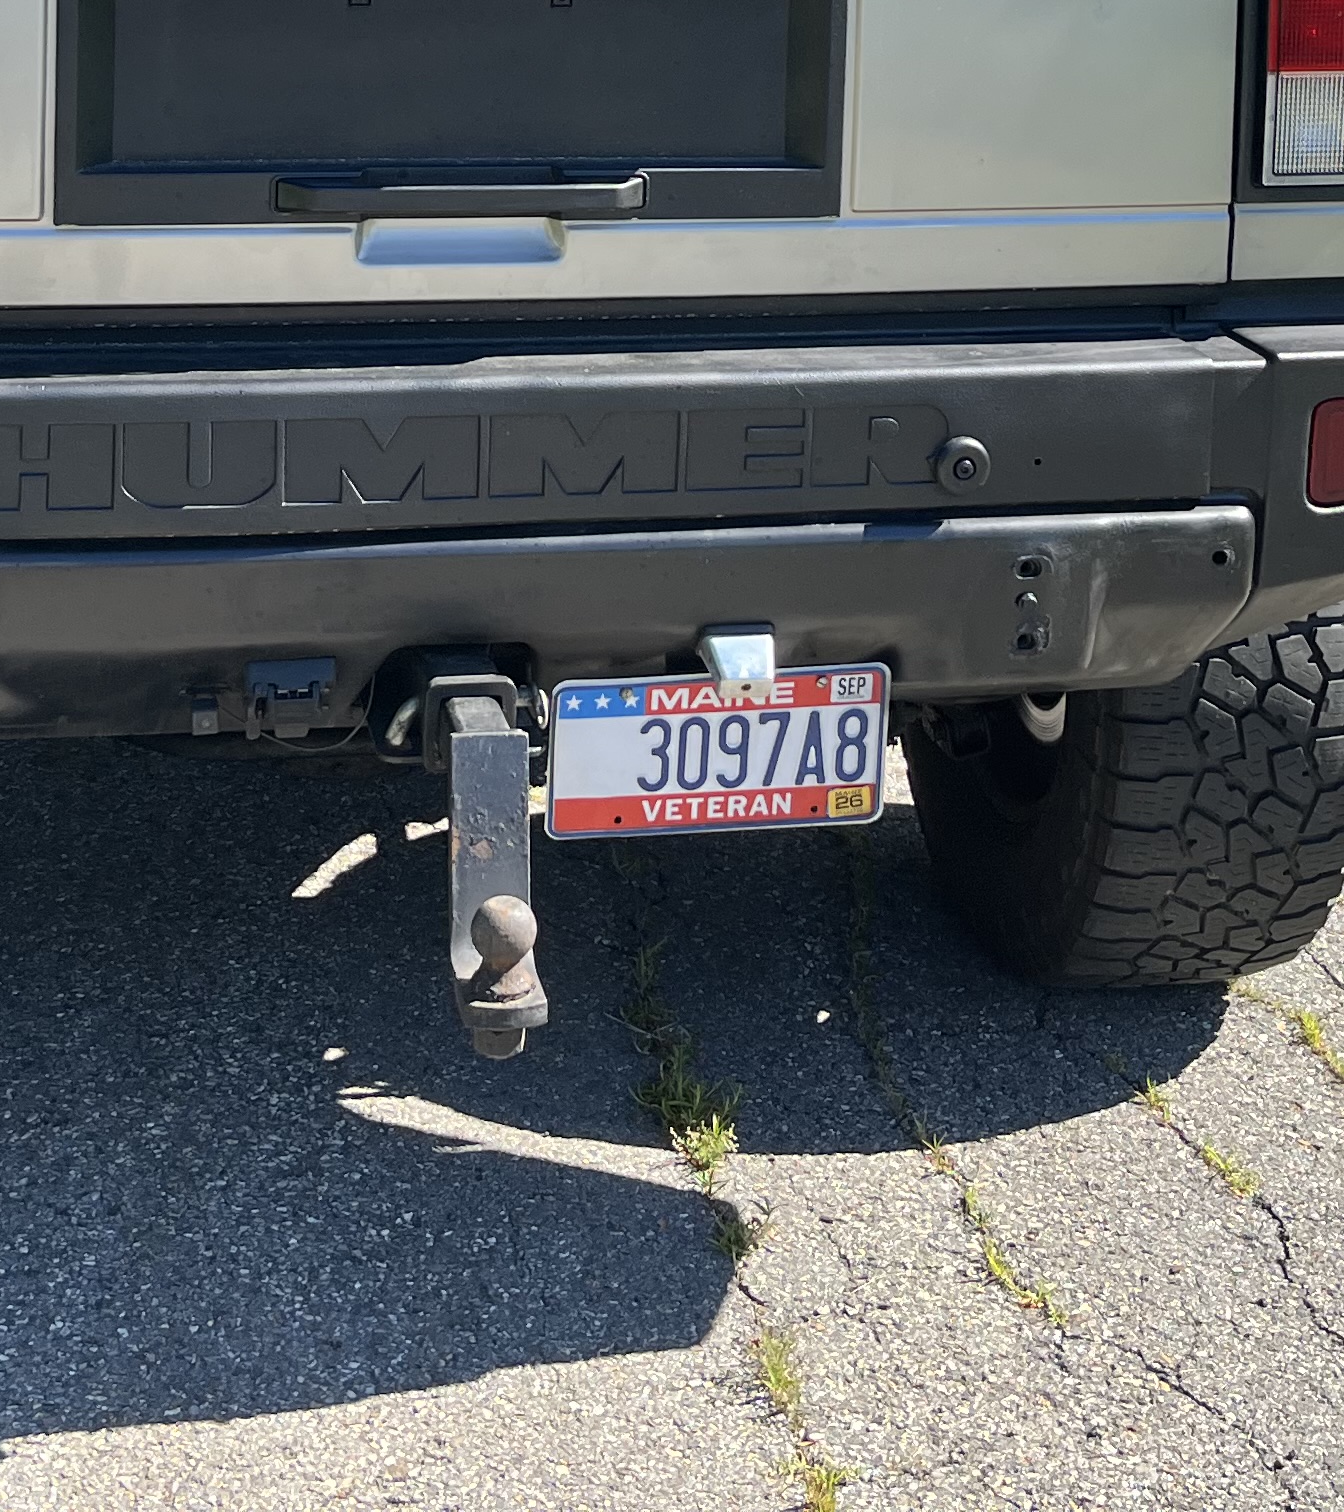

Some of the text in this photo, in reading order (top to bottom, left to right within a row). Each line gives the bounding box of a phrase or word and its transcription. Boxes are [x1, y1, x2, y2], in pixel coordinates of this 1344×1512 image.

[837, 676, 867, 696] SEP
[636, 708, 869, 792] 3097A8
[641, 792, 792, 822] VETERAN
[835, 794, 864, 810] 26
